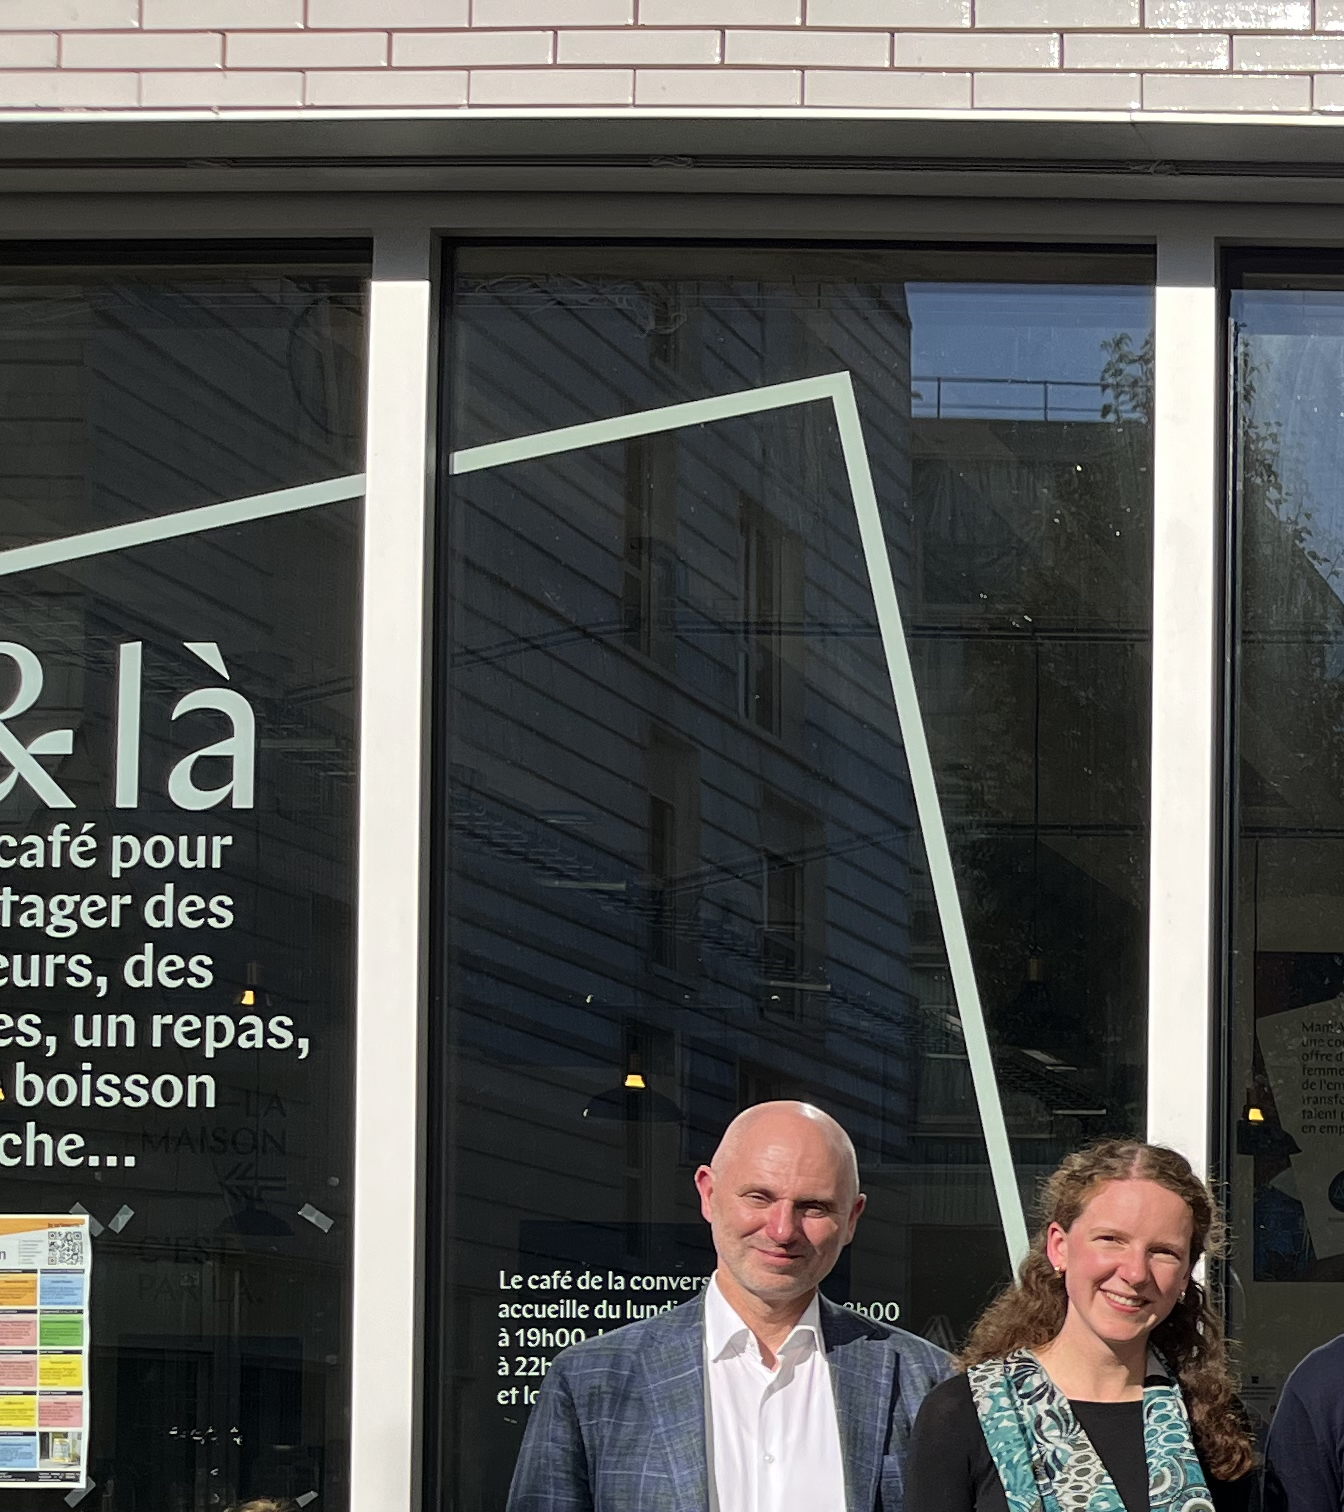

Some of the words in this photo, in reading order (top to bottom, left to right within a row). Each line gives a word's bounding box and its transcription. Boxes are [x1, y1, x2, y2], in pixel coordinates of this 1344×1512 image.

[115, 641, 256, 811] là
[111, 834, 233, 879] pour
[144, 883, 235, 929] des
[123, 943, 214, 988] des
[74, 1013, 136, 1048] un
[152, 1013, 310, 1059] repas,
[1302, 1052, 1332, 1063] offre
[15, 1061, 216, 1108] boisson
[1302, 1080, 1316, 1091] de
[1302, 1109, 1337, 1120] talent
[1302, 1125, 1316, 1135] en
[499, 1270, 524, 1290] Le
[527, 1270, 572, 1290] café
[576, 1270, 603, 1290] de
[608, 1270, 625, 1290] la
[498, 1299, 590, 1319] accueille
[594, 1299, 620, 1319] du
[498, 1328, 510, 1347] à
[497, 1357, 510, 1376] à
[497, 1387, 519, 1405] et
